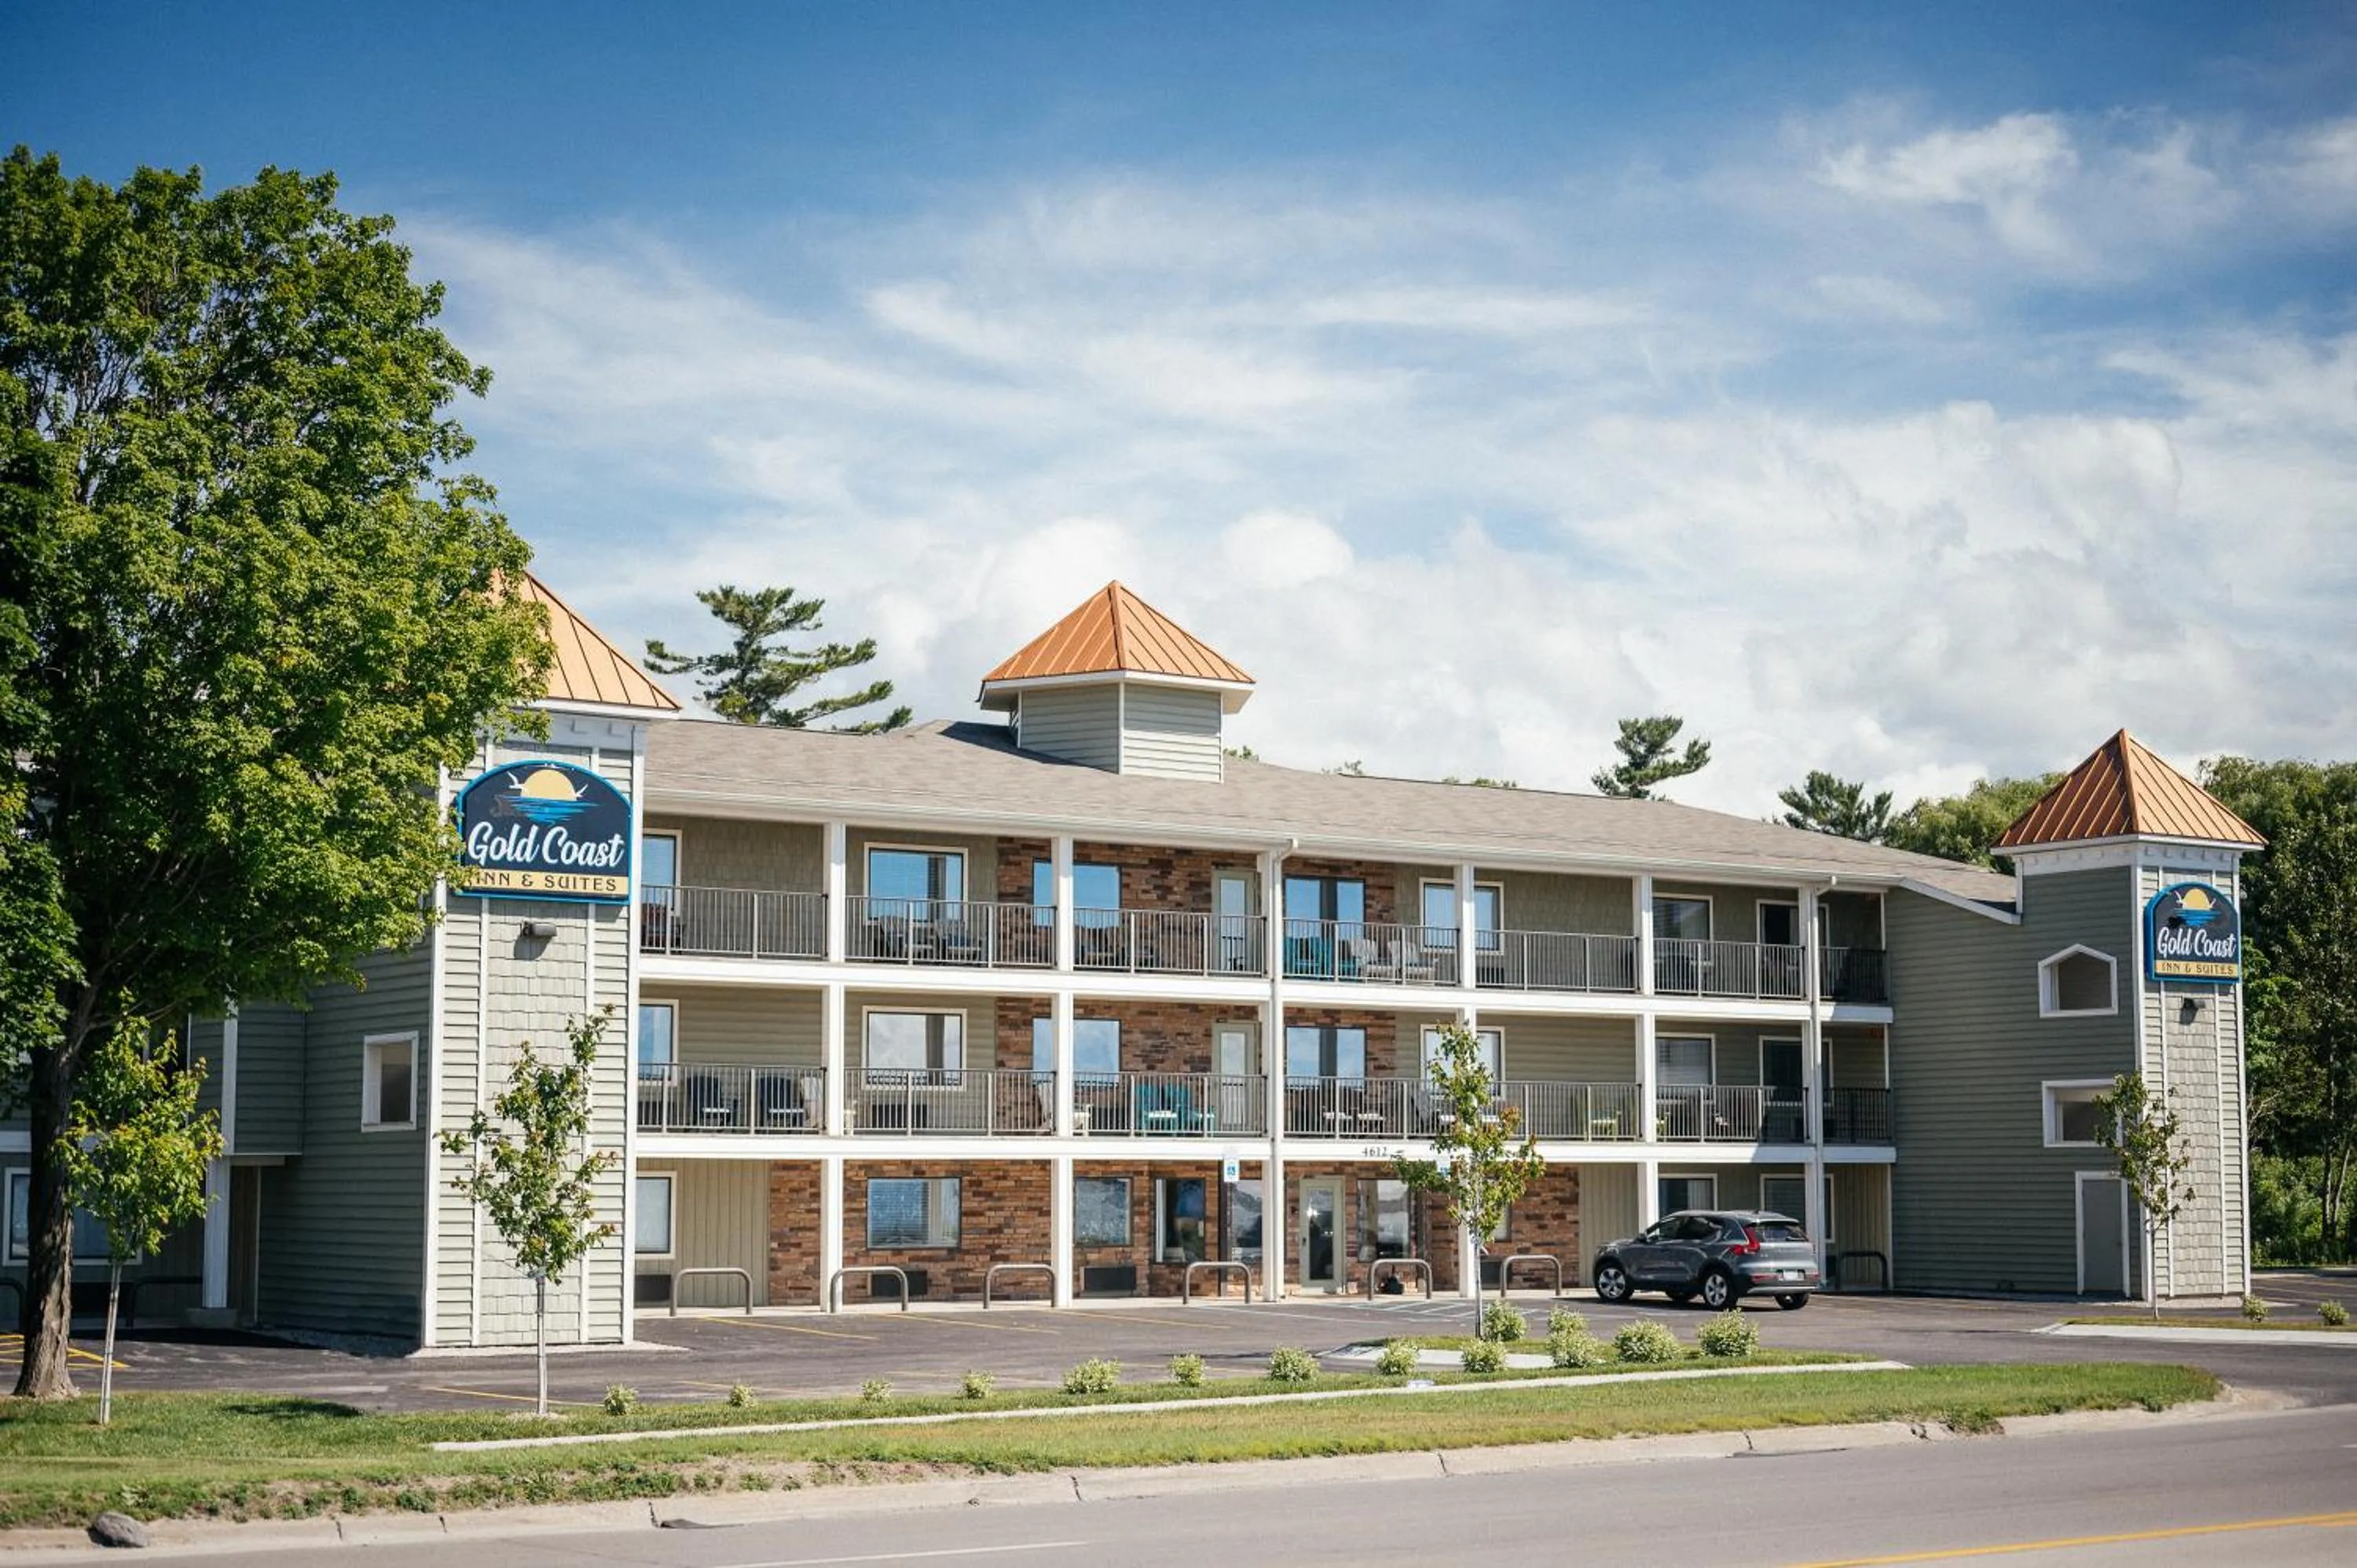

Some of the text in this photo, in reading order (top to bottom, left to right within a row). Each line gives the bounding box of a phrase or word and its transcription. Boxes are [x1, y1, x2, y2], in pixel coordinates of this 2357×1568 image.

[467, 821, 625, 867] Gold Coast
[521, 874, 533, 887] &
[544, 875, 617, 892] SUITES
[2157, 927, 2236, 958] Gold Coast
[2162, 962, 2180, 972] INN
[2196, 964, 2234, 974] SUITES
